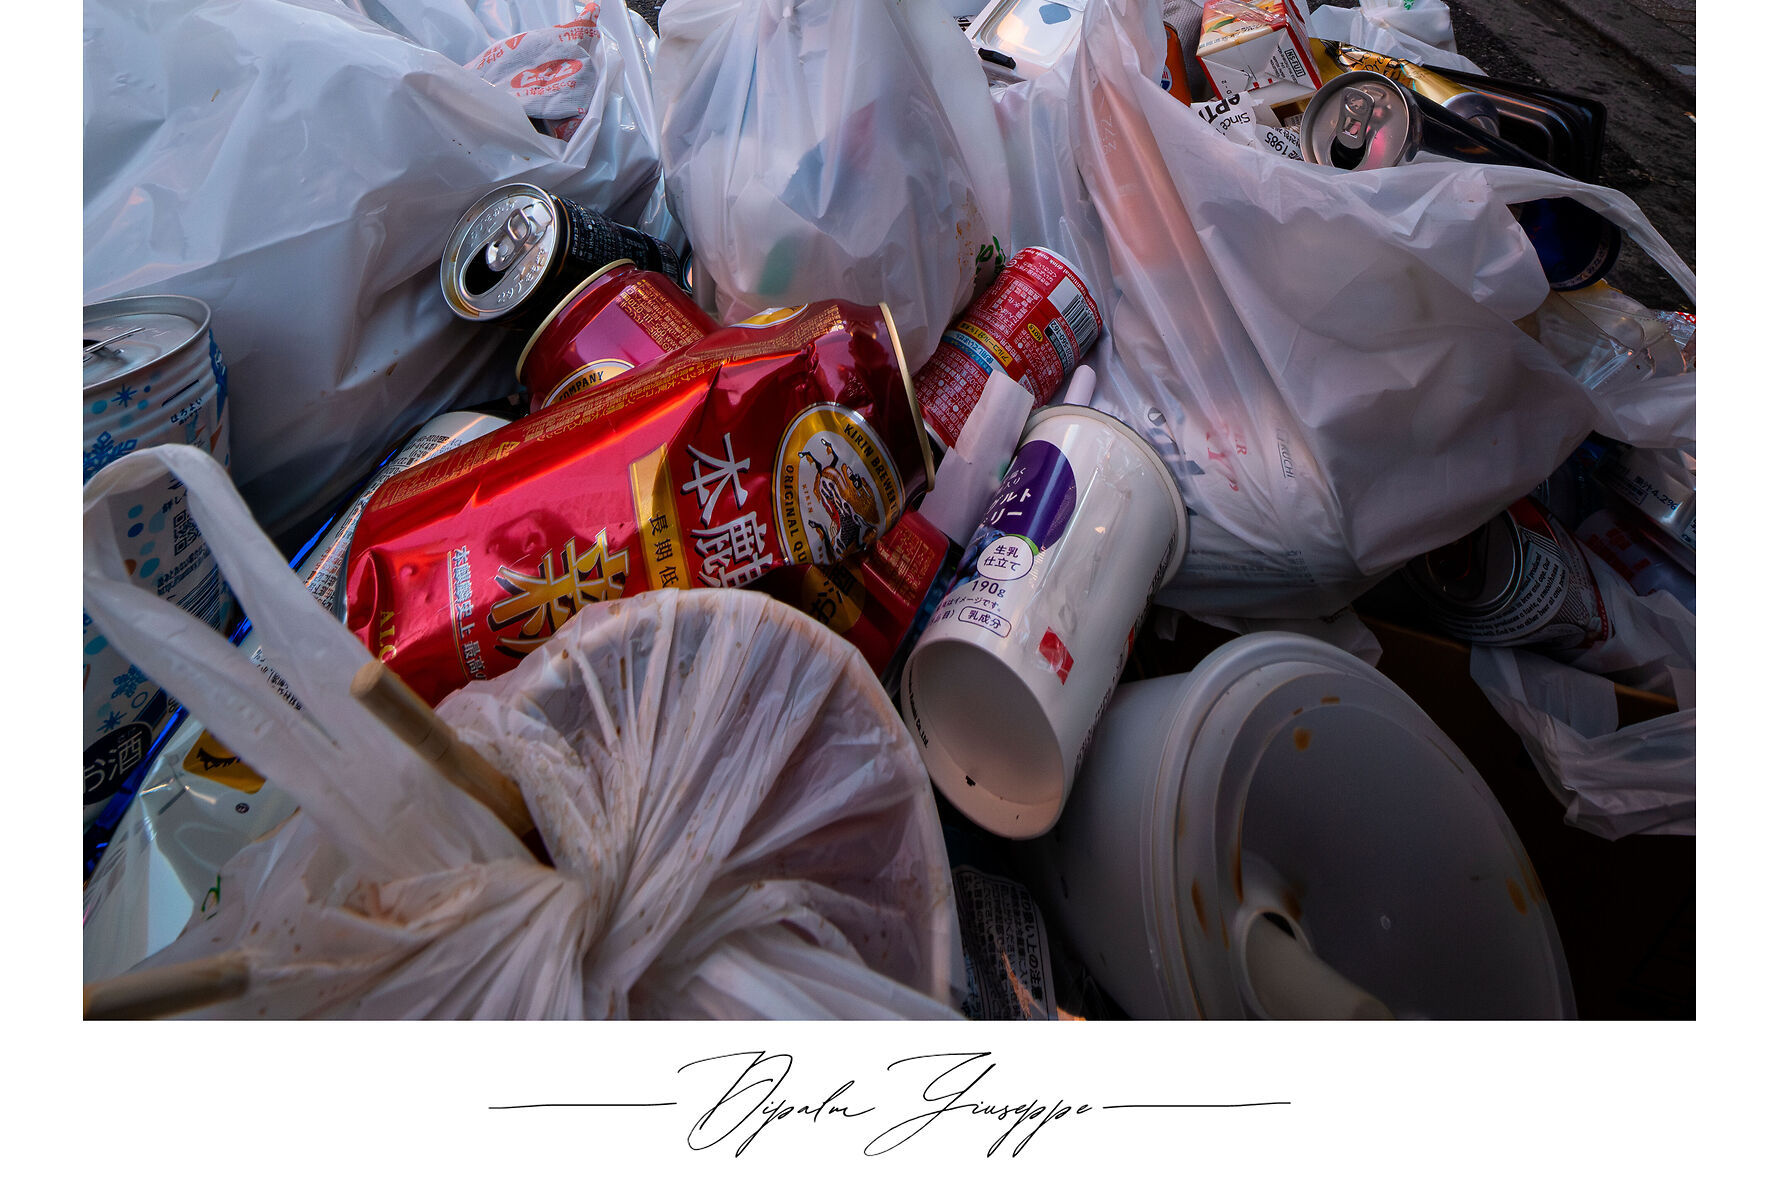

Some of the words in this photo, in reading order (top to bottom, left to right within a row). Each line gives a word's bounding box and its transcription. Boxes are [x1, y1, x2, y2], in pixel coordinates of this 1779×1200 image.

[1264, 131, 1289, 157] 1985
[1048, 257, 1065, 270] drink
[1061, 267, 1089, 296] traditional
[627, 298, 666, 337] 0120-111-560
[170, 397, 204, 425] ほろよい
[843, 423, 875, 459] KIRIN
[785, 464, 801, 537] ORIGINAL
[801, 483, 815, 515] KIRIN
[983, 556, 1022, 572] 仕立て
[993, 544, 1019, 559] 生乳
[971, 579, 1007, 599] 190g
[967, 608, 1003, 631] 乳成分
